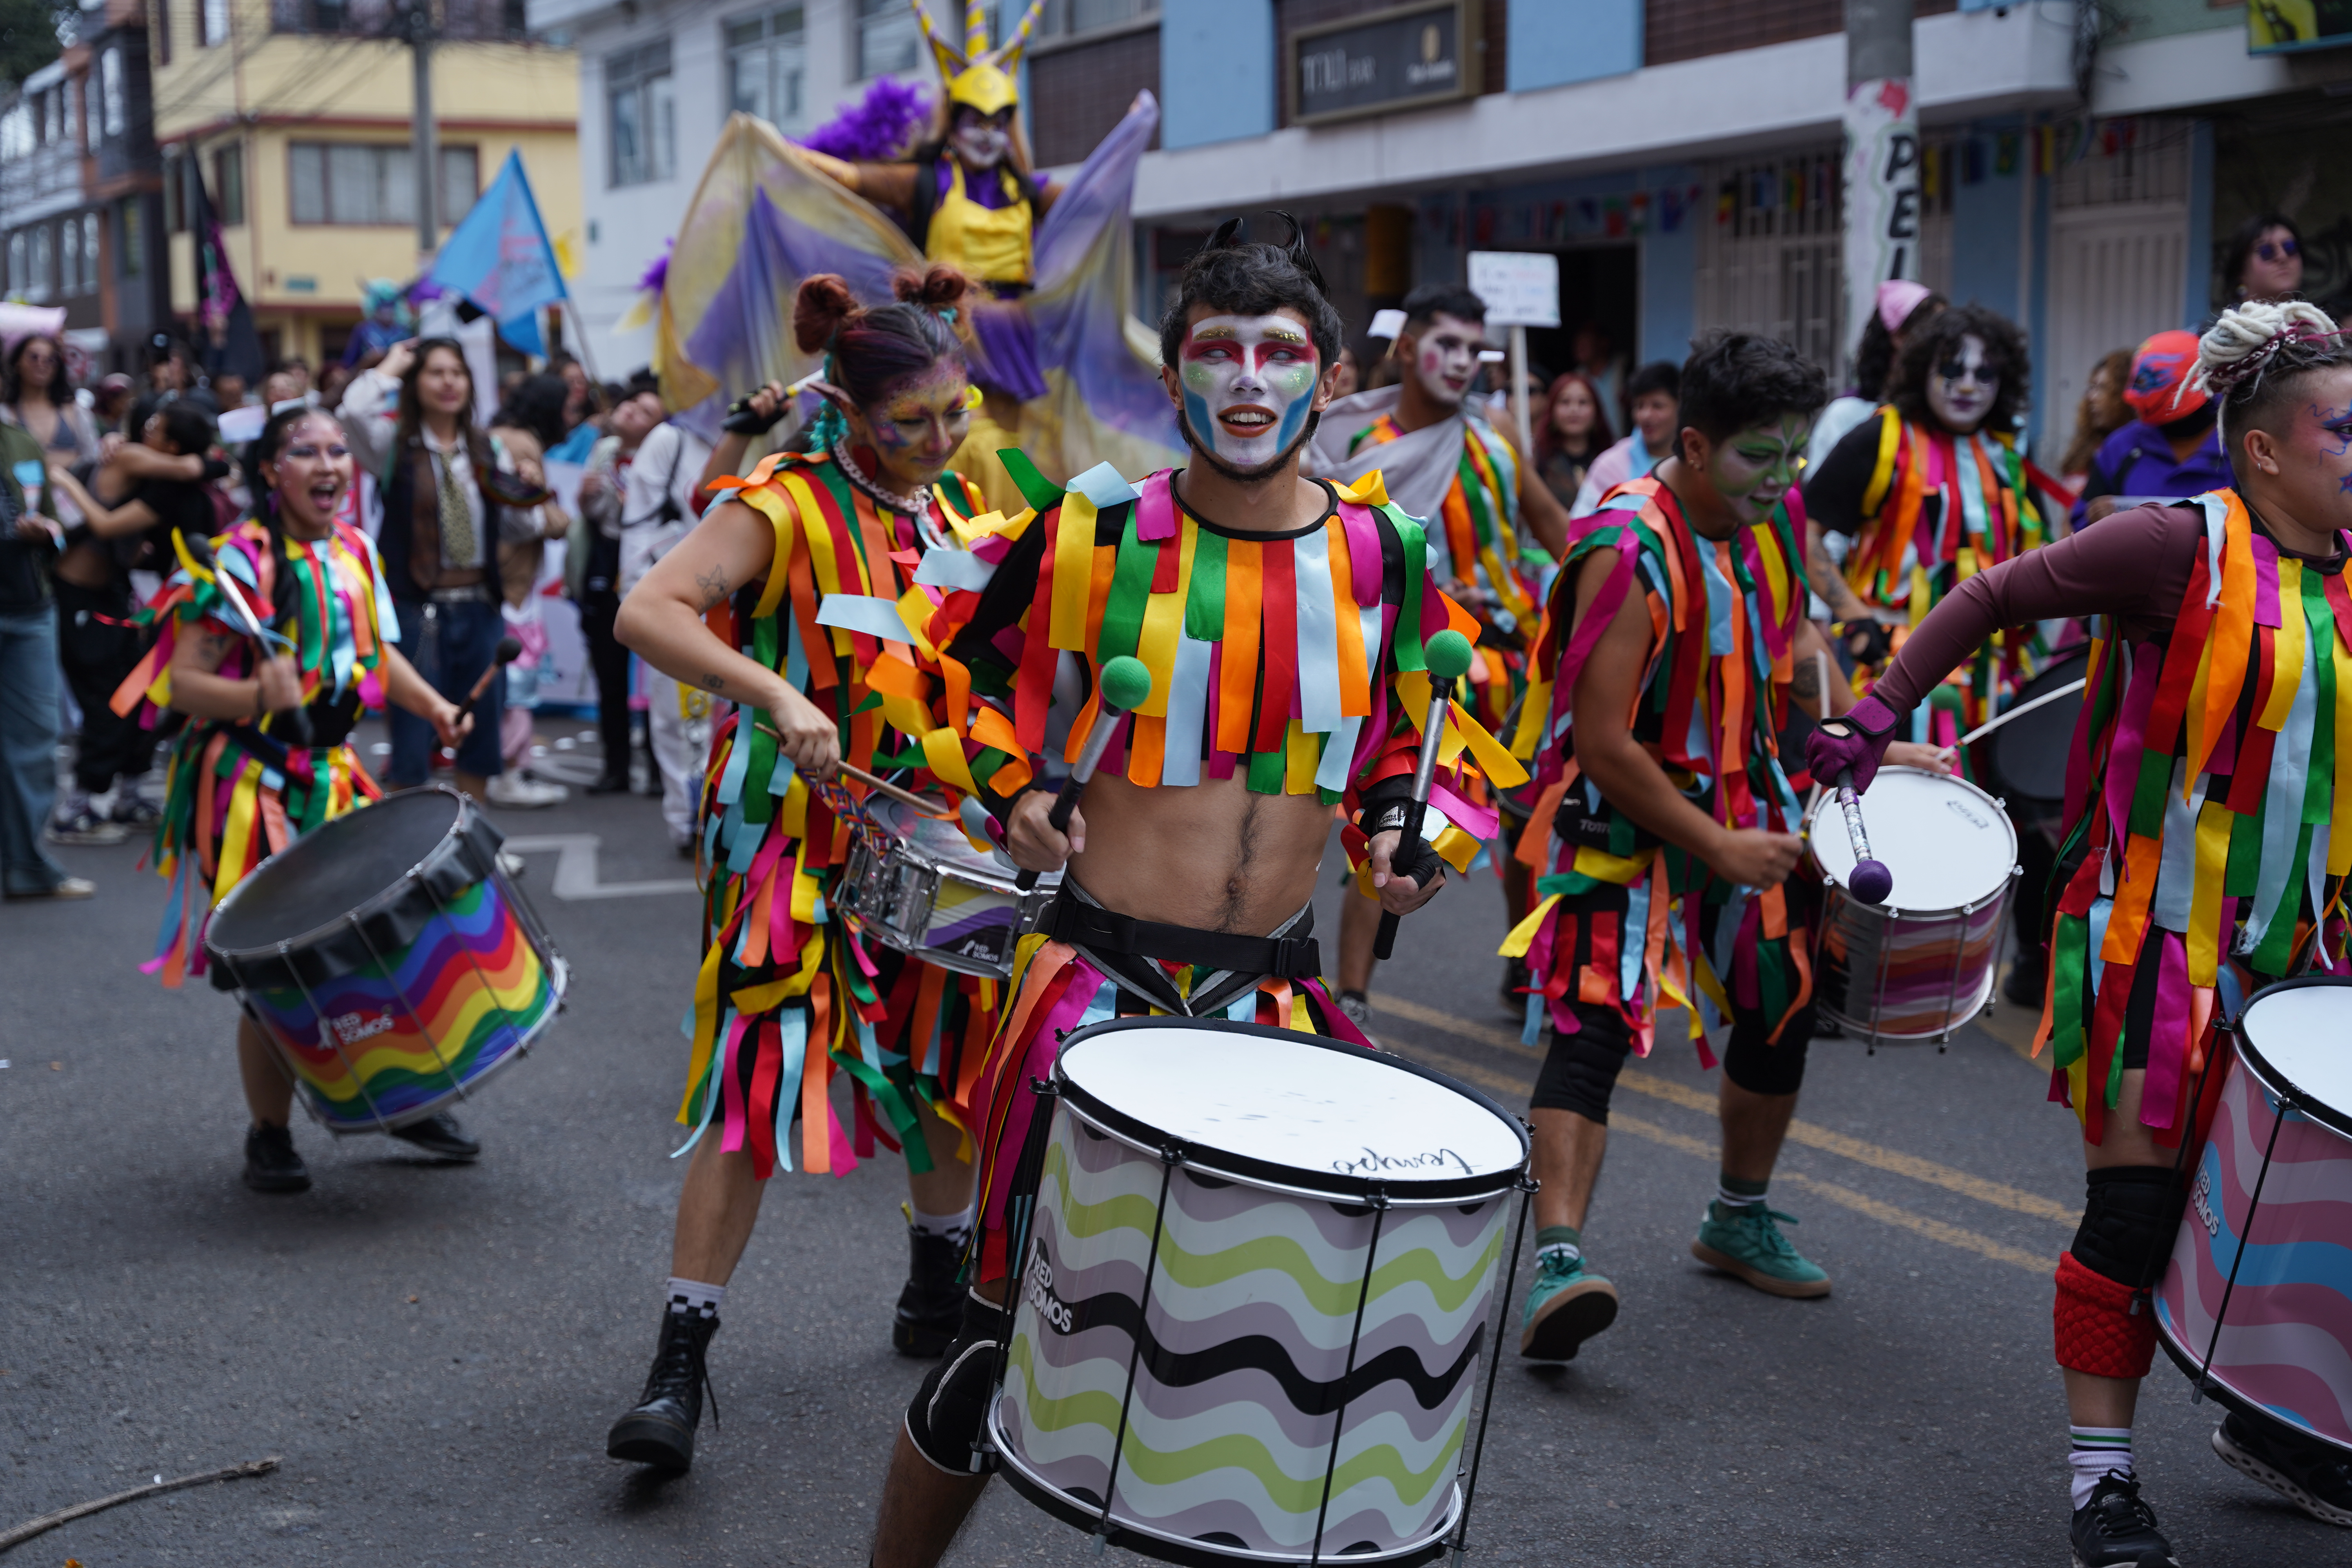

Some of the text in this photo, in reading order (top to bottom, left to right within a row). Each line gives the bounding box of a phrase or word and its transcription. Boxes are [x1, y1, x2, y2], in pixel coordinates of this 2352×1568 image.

[972, 951, 1000, 963] SOMOS
[974, 943, 989, 953] RED
[332, 1012, 362, 1032] RED
[339, 1013, 395, 1045] SOMOS
[2200, 1163, 2210, 1195] RED
[2193, 1182, 2219, 1235] SOMOS
[1033, 1252, 1053, 1289] RED
[1029, 1278, 1072, 1332] SOMOS
